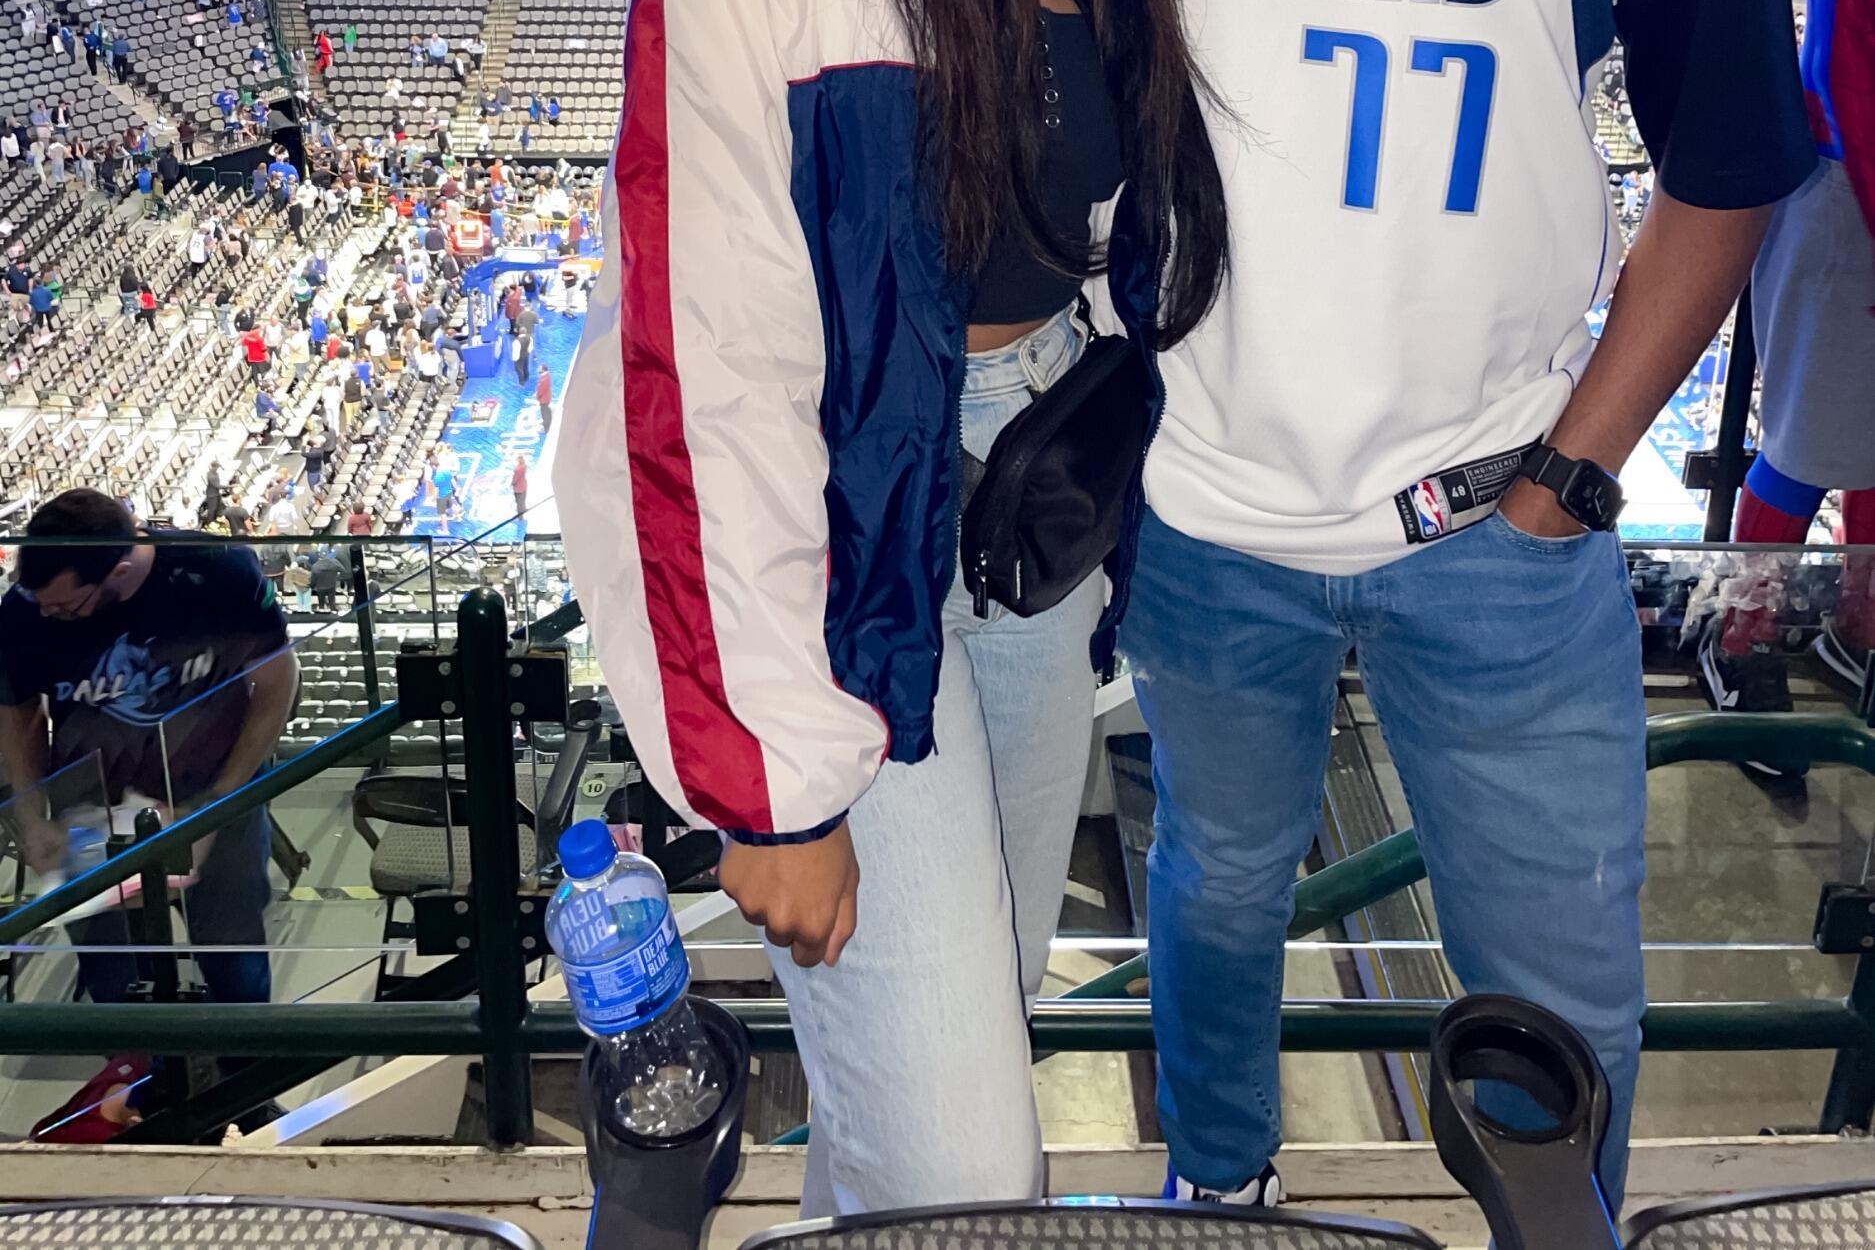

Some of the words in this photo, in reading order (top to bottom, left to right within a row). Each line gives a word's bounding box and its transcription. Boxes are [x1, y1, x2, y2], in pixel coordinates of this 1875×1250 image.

[1300, 24, 1499, 217] 77
[1468, 457, 1519, 476] ENGINEERED
[1451, 485, 1466, 497] 48
[588, 784, 602, 792] 10
[643, 932, 666, 964] DEJA
[647, 948, 669, 977] BLUE
